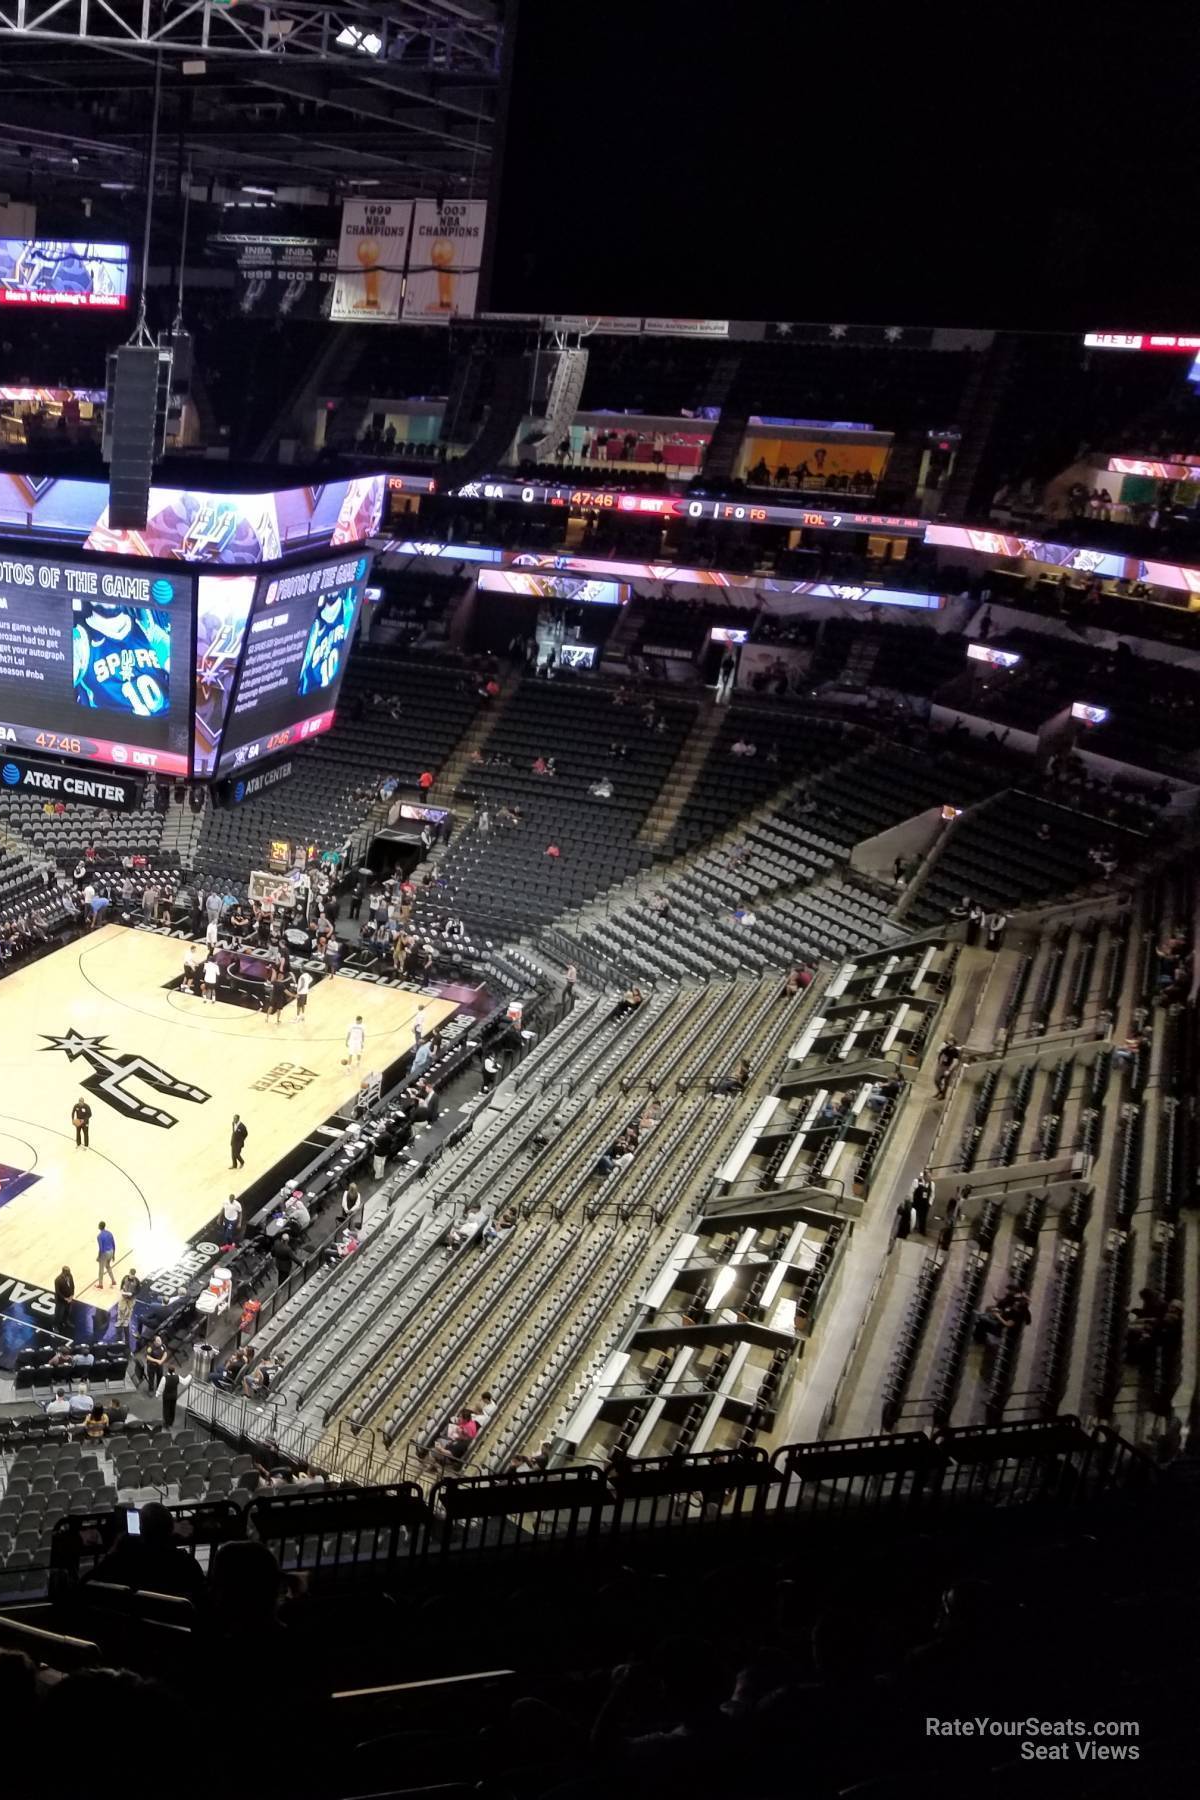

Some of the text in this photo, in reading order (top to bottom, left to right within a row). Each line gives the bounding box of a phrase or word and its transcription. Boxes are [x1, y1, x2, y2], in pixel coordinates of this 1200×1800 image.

[364, 205, 392, 215] 1999
[366, 215, 386, 226] NBA
[440, 216, 460, 227] NBA
[346, 225, 405, 237] CHAMPIONS
[418, 225, 480, 238] CHAMPIONS
[521, 487, 535, 503] 0
[571, 491, 613, 507] 47:46
[689, 501, 703, 517] 0
[750, 509, 767, 520] FG
[803, 513, 825, 526] TOL
[831, 515, 842, 527] 7
[38, 565, 60, 589] OF
[65, 569, 97, 595] THE
[101, 574, 150, 601] GAME
[275, 560, 358, 602] PHOTOS OF THE GAME
[11, 622, 31, 633] game
[32, 625, 48, 635] with
[49, 627, 62, 637] the
[22, 634, 36, 645] had
[37, 637, 46, 646] to
[46, 639, 59, 649] get
[0, 643, 11, 653] get
[12, 645, 28, 655] your
[28, 648, 65, 661] autograph
[14, 656, 25, 666] Lol
[25, 669, 45, 681] #nba
[121, 673, 165, 717] 10
[35, 731, 82, 754] 47:46
[23, 770, 126, 803] AT&T CENTER
[245, 761, 292, 796] AT&T CENTER
[134, 922, 194, 941] SAN
[335, 967, 443, 998] SPURS
[247, 1061, 296, 1092] CENTER
[269, 1066, 320, 1100] AT&T
